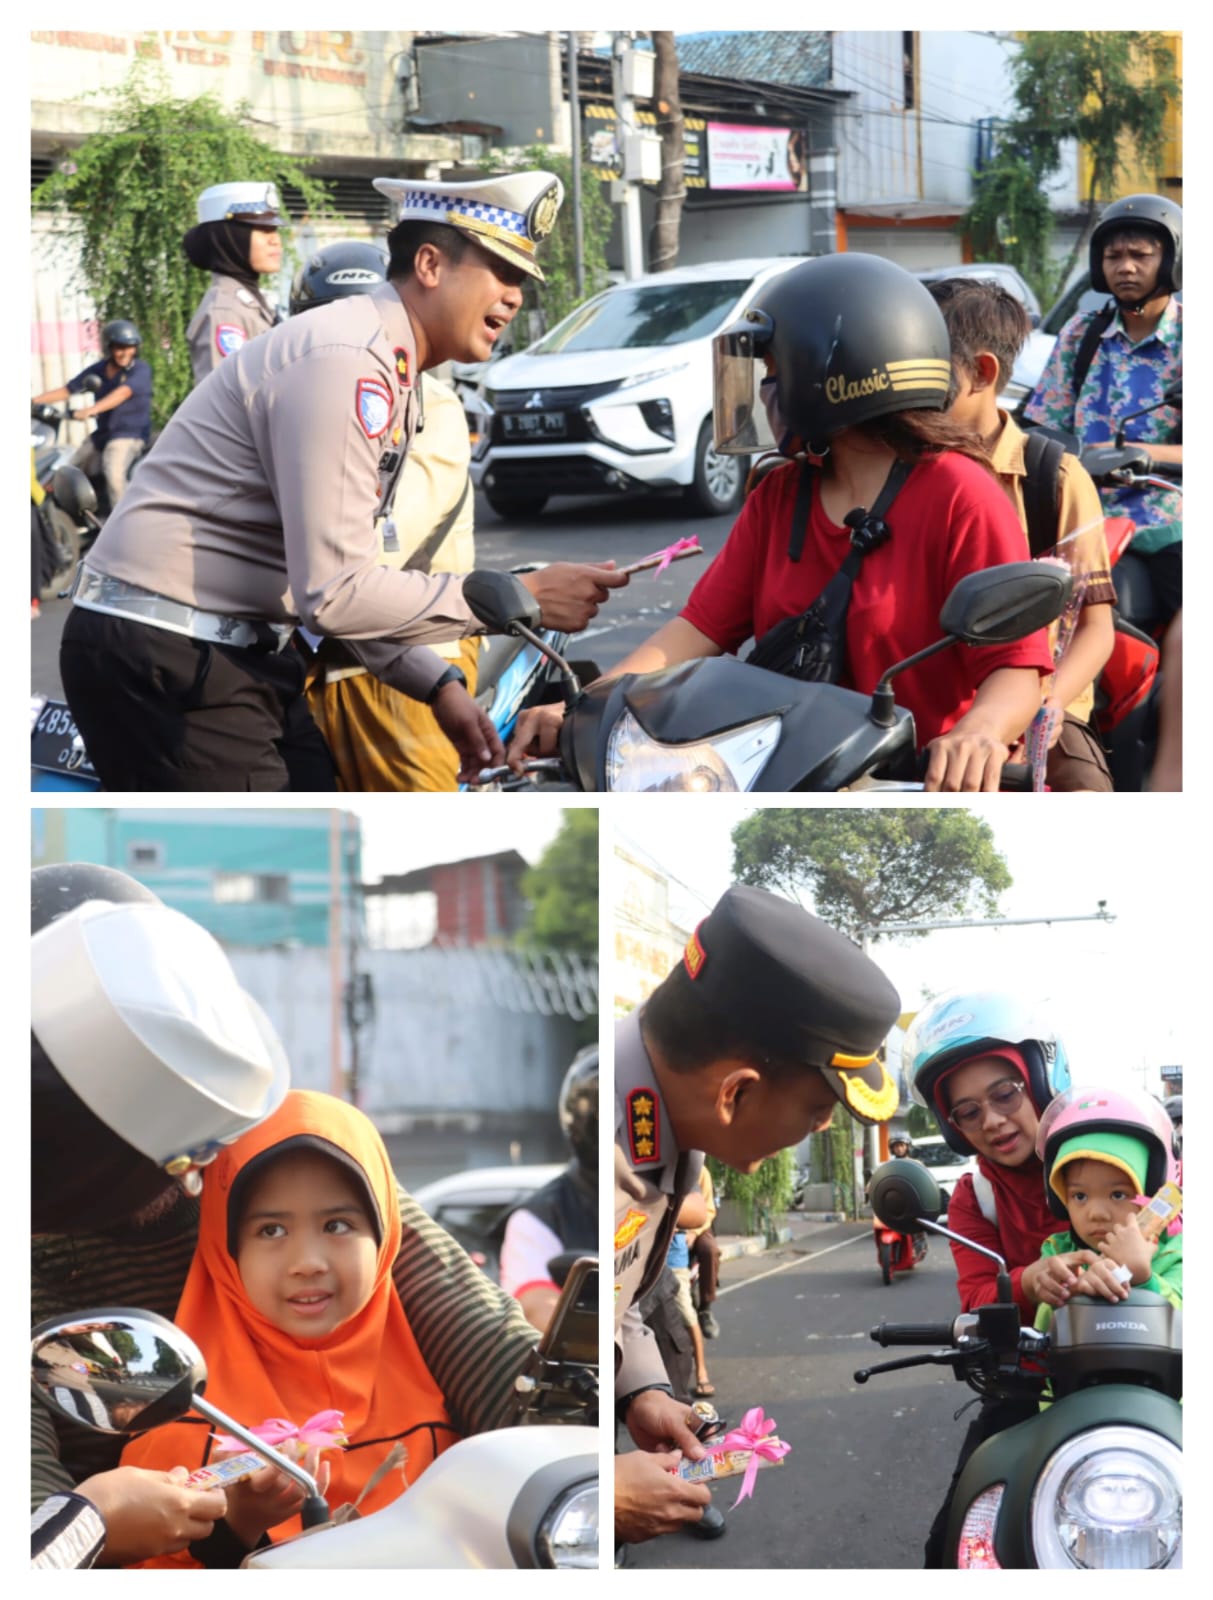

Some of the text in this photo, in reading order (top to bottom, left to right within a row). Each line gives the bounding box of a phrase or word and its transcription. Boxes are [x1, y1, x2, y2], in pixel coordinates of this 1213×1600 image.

[332, 272, 376, 281] INK
[825, 368, 890, 405] Classic
[1095, 1320, 1149, 1332] HONDA
